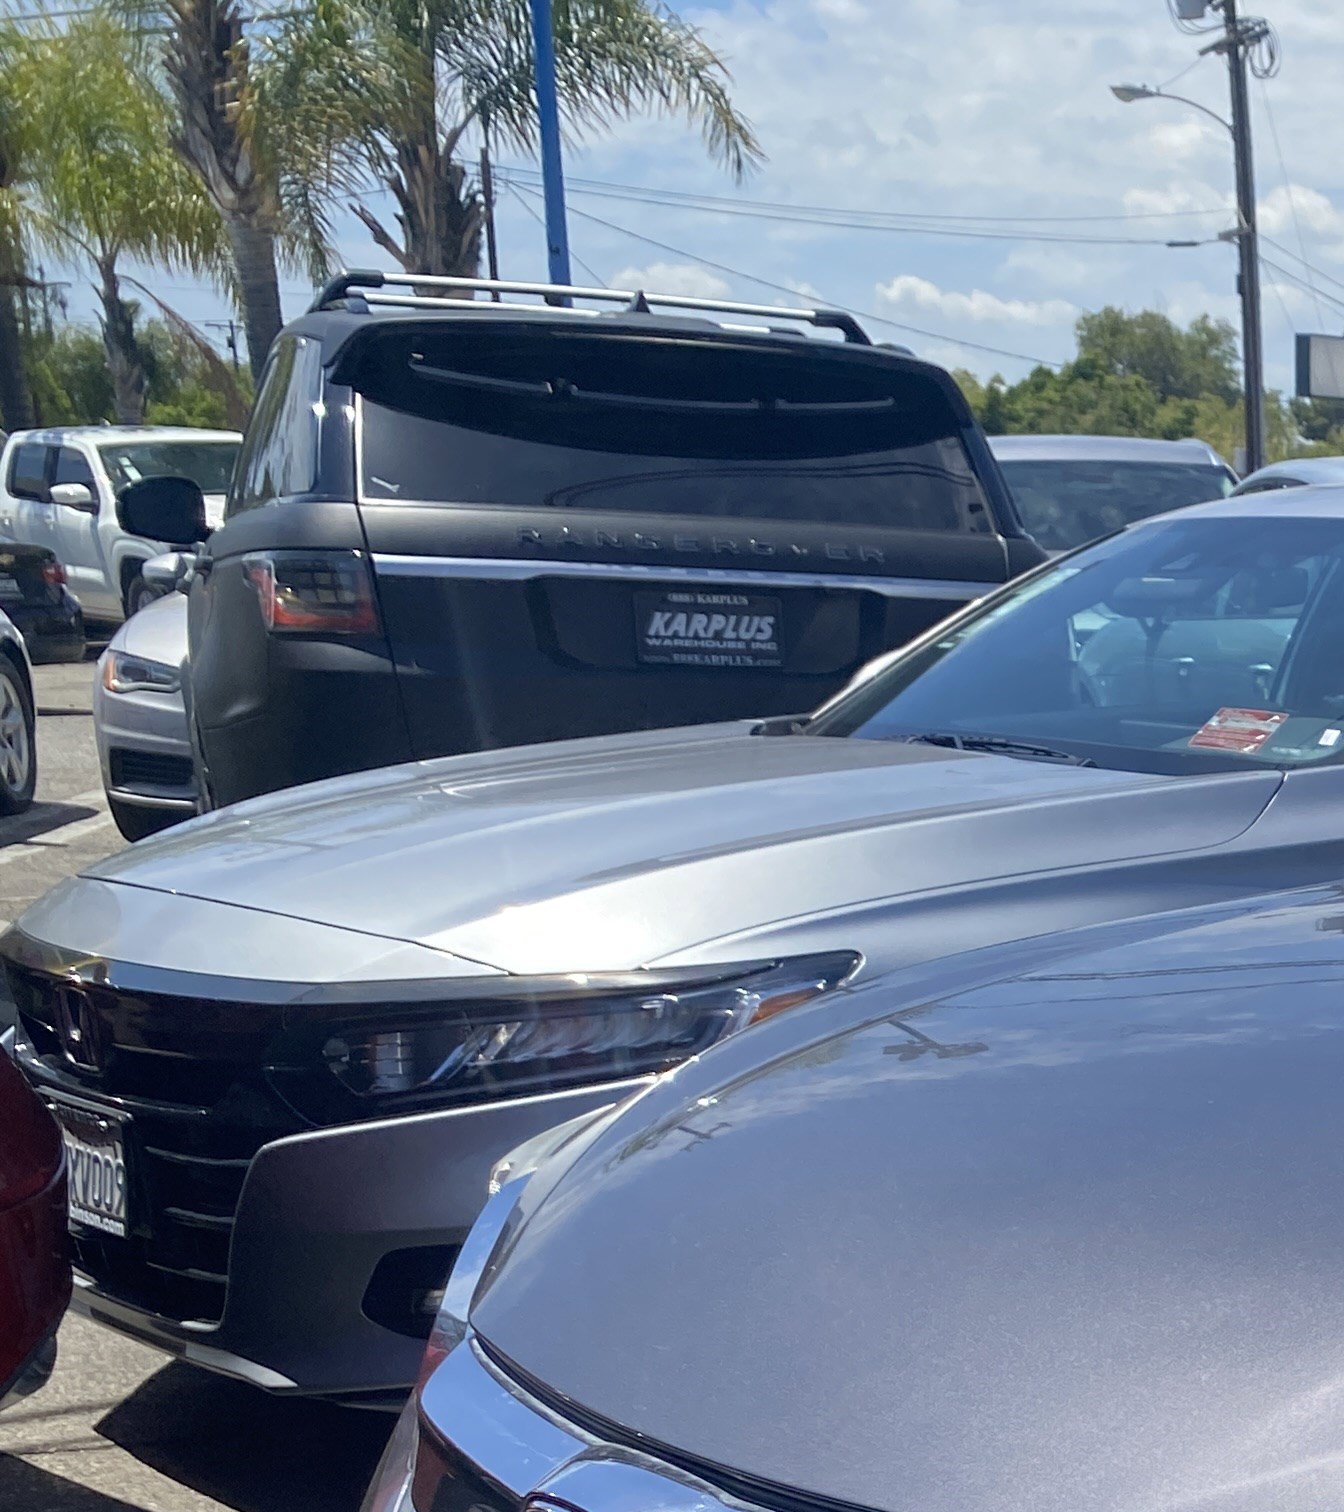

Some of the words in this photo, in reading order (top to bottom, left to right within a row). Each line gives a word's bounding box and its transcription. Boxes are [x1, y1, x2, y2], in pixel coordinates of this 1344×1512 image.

[648, 611, 775, 641] KARPLUS
[646, 638, 746, 649] WAREHOUSE
[751, 641, 778, 651] INC
